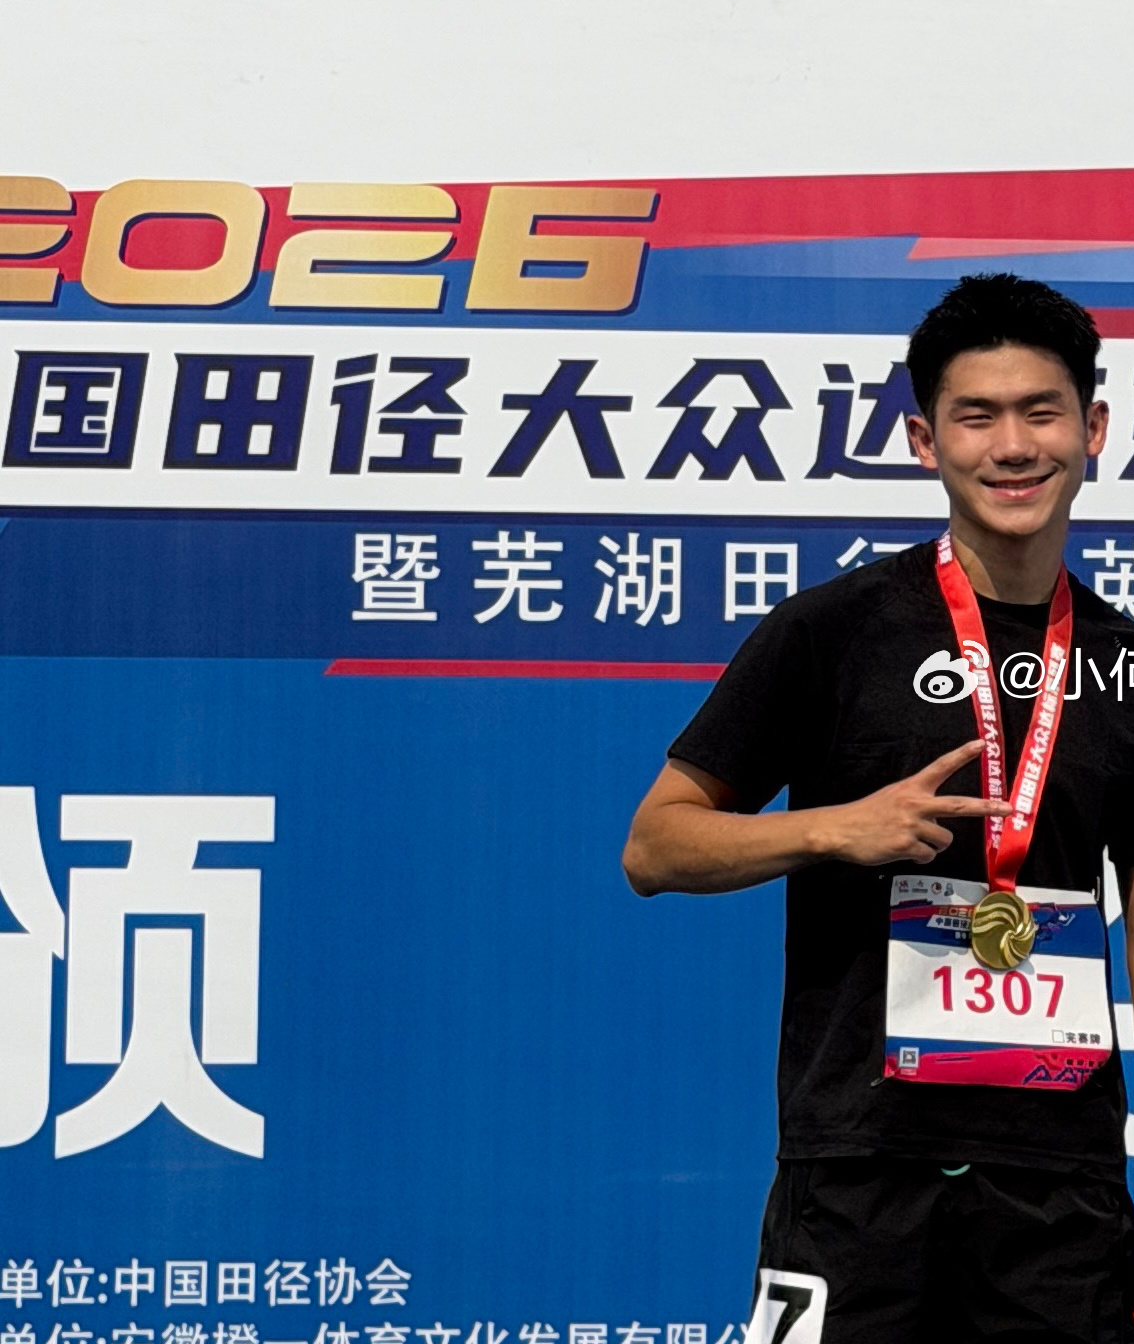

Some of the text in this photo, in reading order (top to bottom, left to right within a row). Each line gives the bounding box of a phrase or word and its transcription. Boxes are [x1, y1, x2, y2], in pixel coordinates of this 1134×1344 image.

[933, 965, 1065, 1019] 1307
[0, 1257, 412, 1309] 单位:中国田径协会
